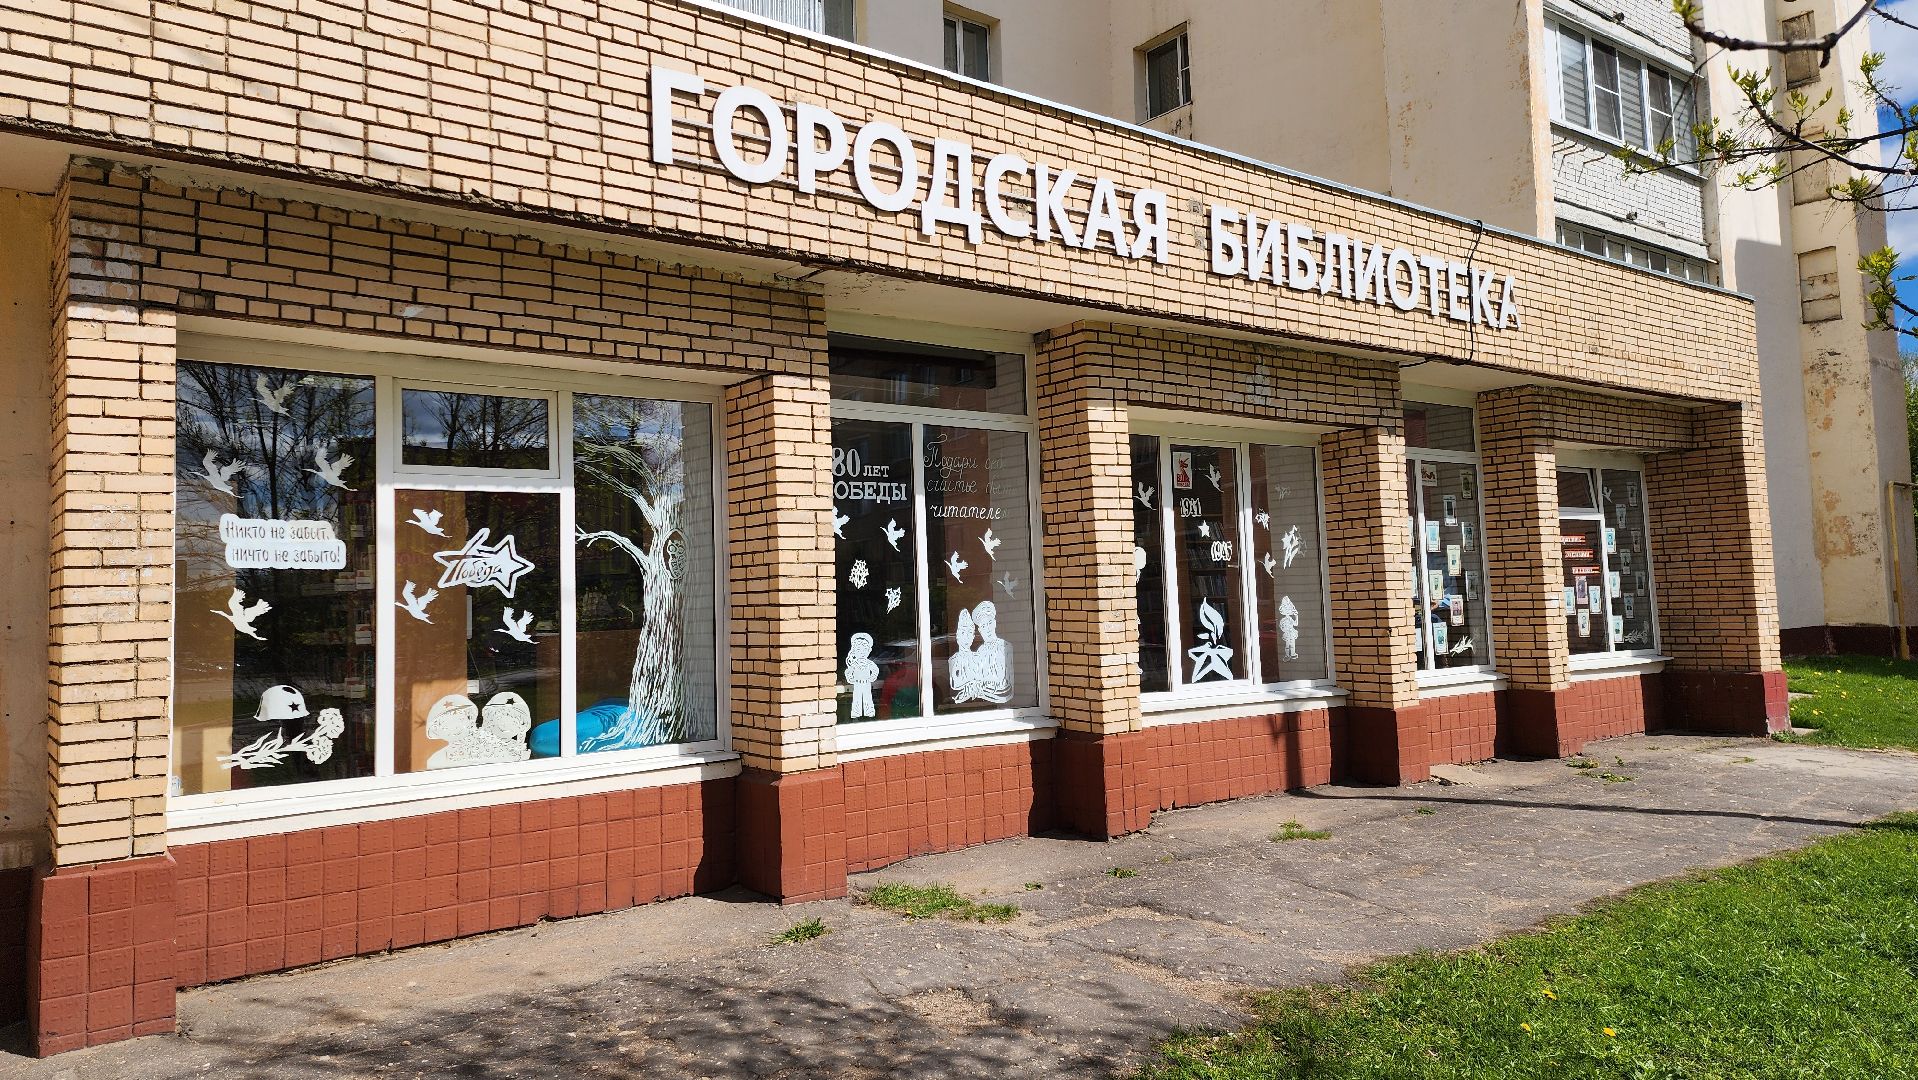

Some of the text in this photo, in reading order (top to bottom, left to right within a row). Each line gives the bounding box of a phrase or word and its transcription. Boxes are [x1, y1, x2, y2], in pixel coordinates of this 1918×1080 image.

[650, 65, 1521, 330] ГОРОДСКАЯ БИБЛИОТЕКА
[832, 447, 890, 477] 80 ЛЕТ
[833, 481, 908, 504] ОБЕДЫ
[1180, 498, 1202, 517] 1941
[225, 520, 266, 539] Никто
[271, 526, 285, 539] не
[232, 545, 340, 563] ничто не забыто!
[1211, 541, 1233, 561] 1945
